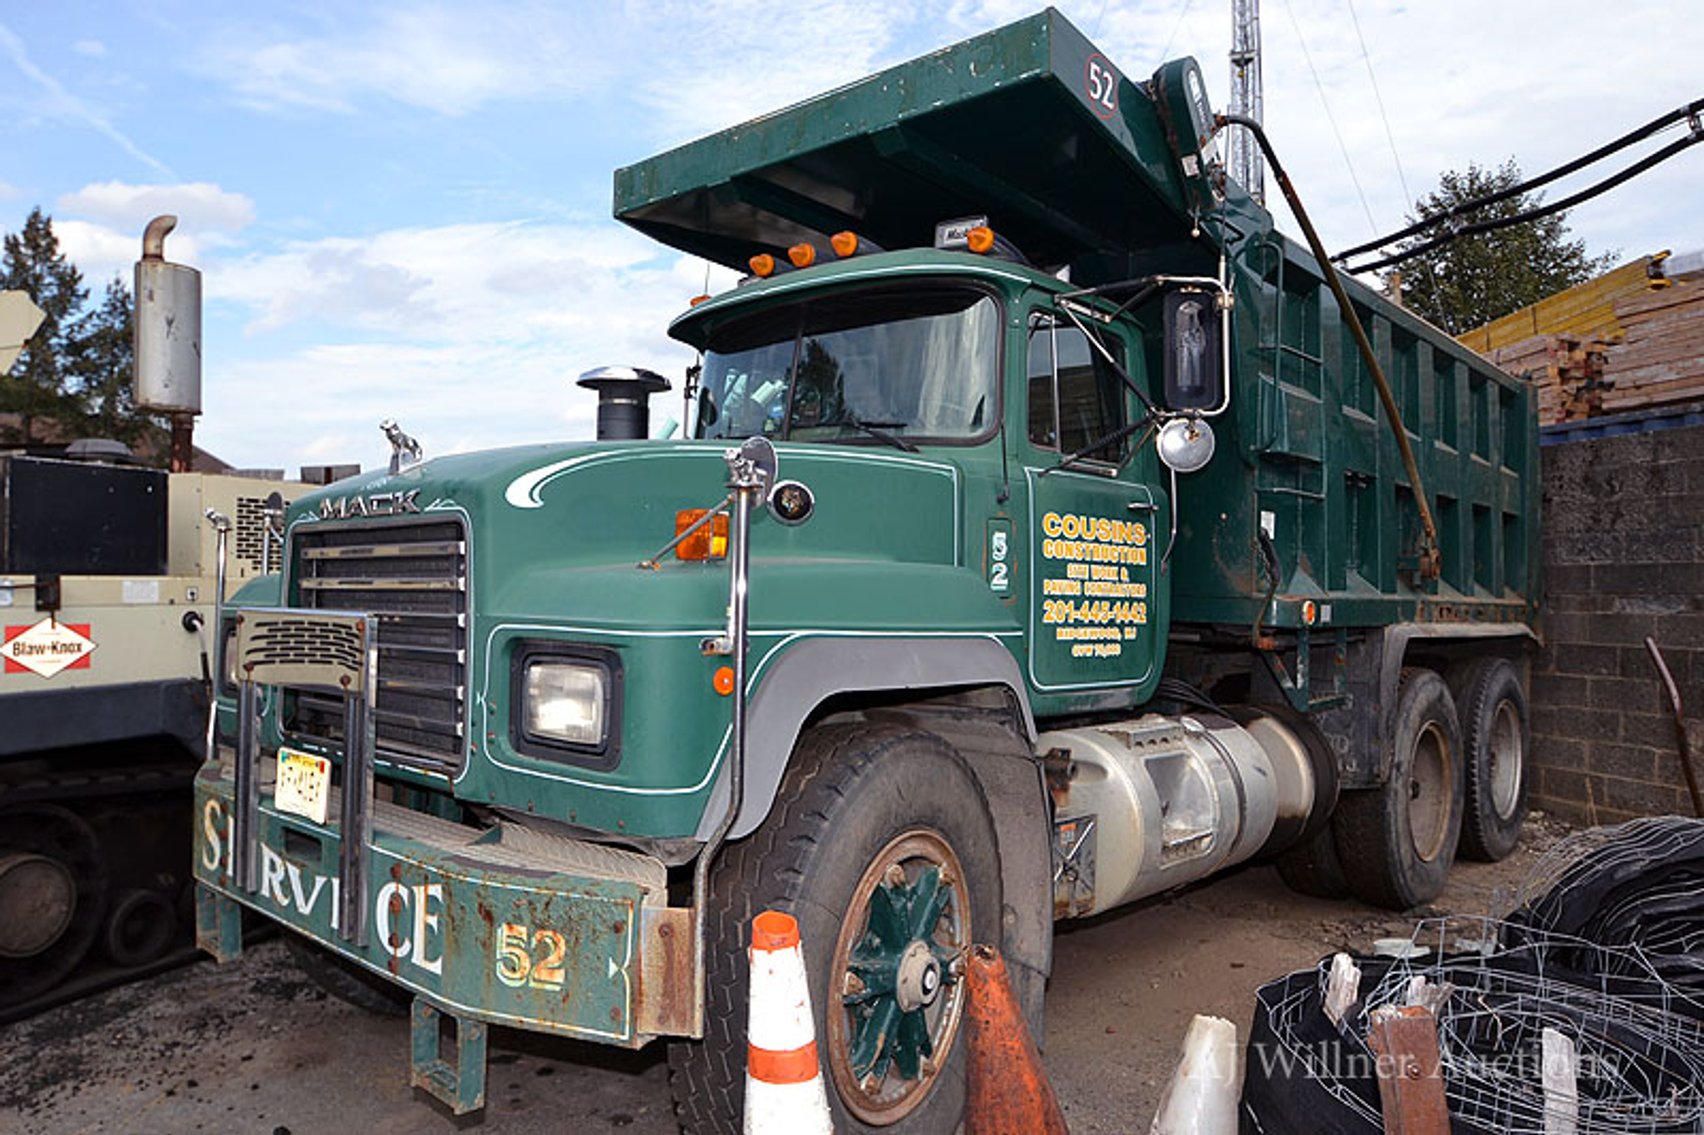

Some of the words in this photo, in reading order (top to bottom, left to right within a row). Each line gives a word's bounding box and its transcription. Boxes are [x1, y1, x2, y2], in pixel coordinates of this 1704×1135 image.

[1089, 61, 1115, 111] 52
[319, 488, 421, 520] MACK
[1043, 512, 1146, 546] COUSINS
[990, 531, 1009, 591] 52
[1043, 539, 1147, 566] CONSTRUCTION
[1091, 564, 1118, 580] WORK
[1043, 579, 1081, 595] PAVING
[1043, 600, 1147, 624] 201-445-1442
[13, 640, 82, 657] Blaw-Knox
[496, 922, 567, 991] 52
